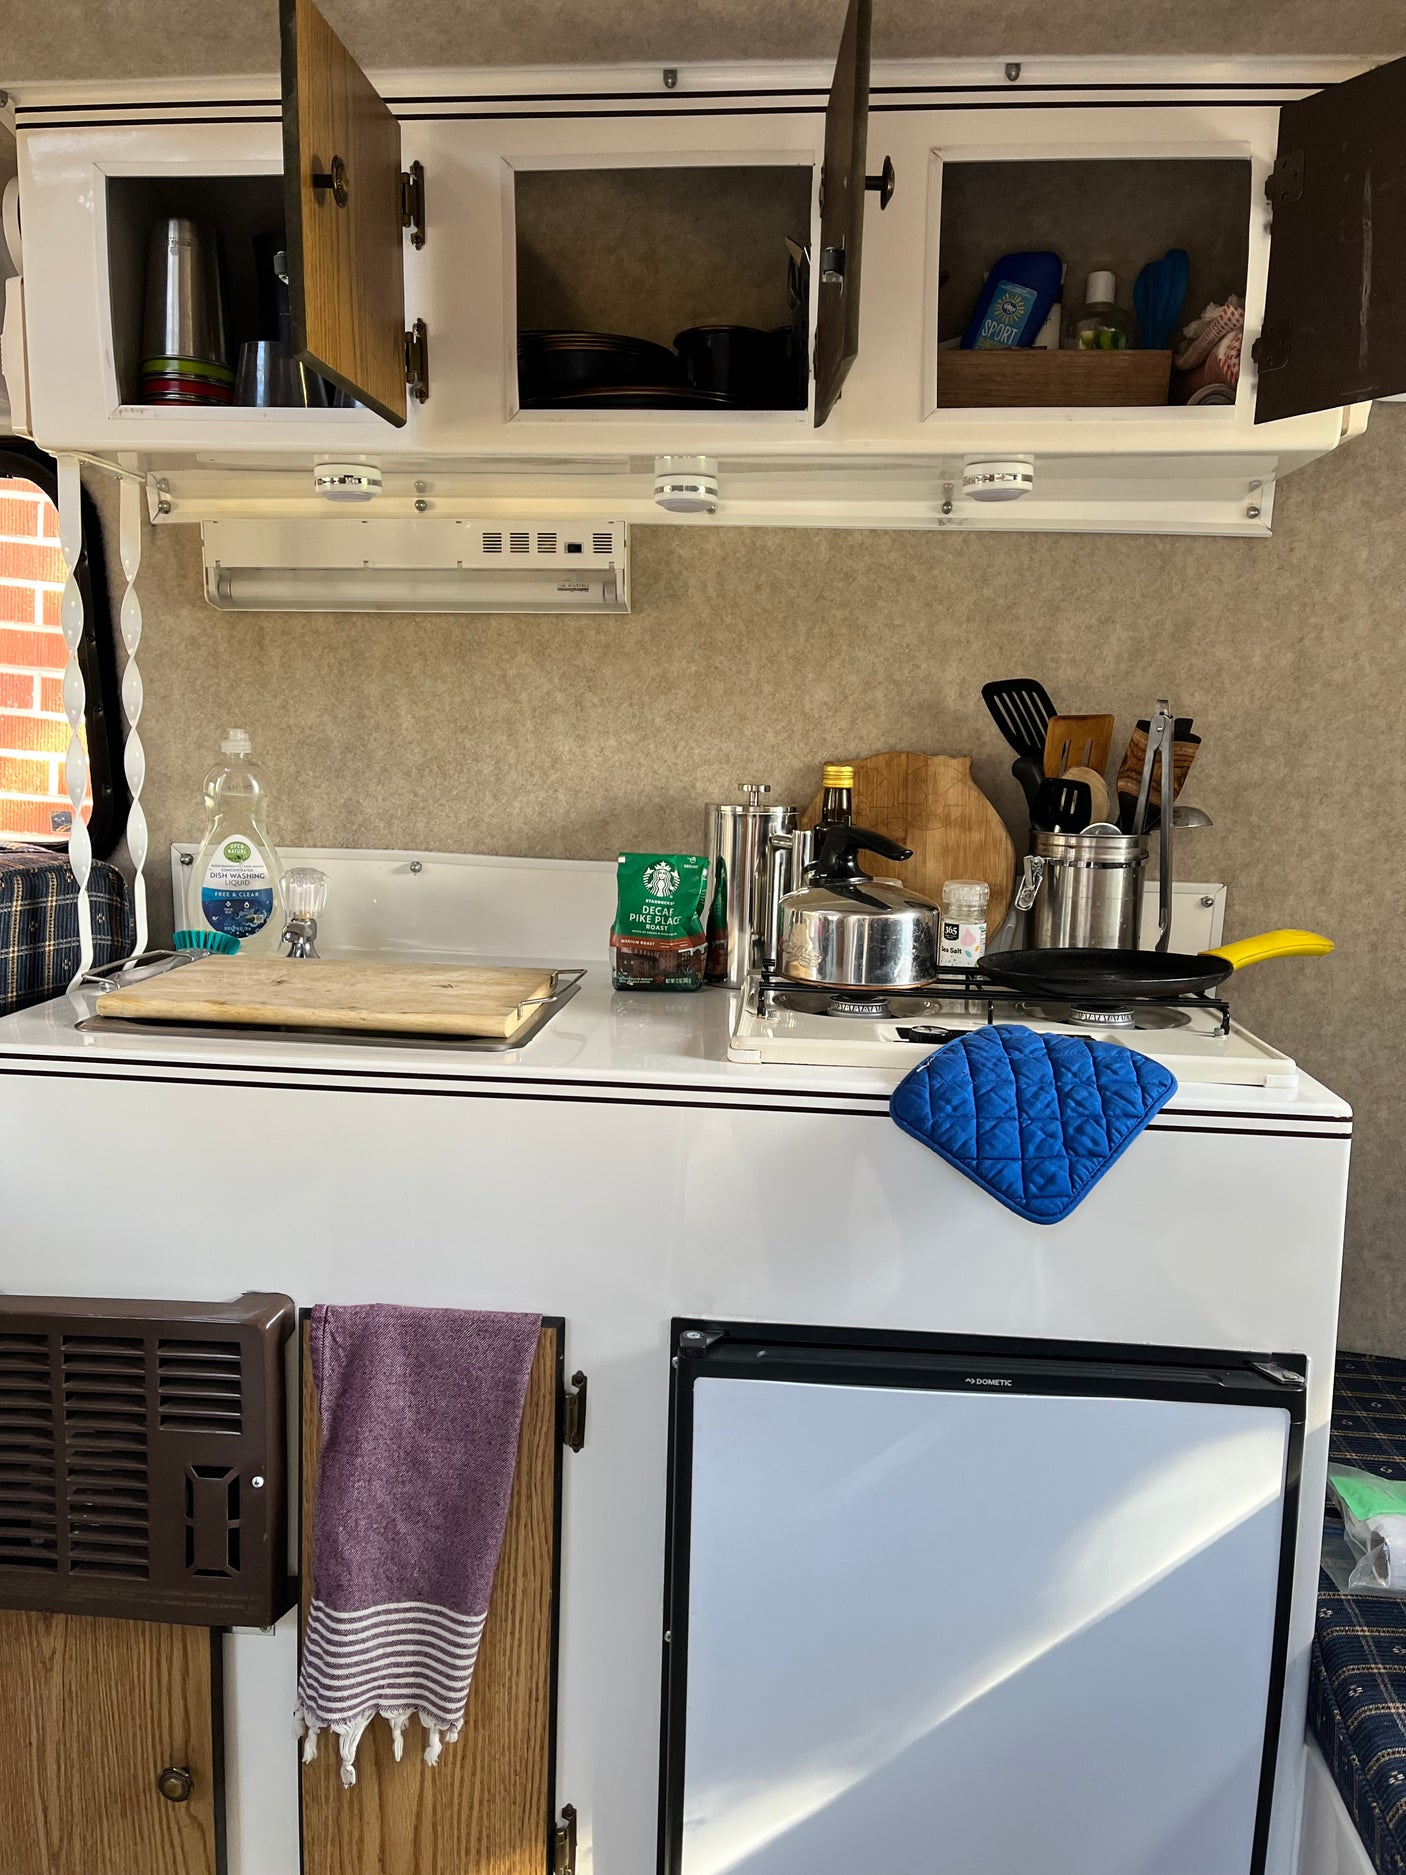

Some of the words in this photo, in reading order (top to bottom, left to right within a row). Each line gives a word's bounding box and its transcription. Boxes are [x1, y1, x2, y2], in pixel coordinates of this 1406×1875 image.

[981, 319, 1019, 345] SPORT
[642, 905, 674, 916] DECAF
[629, 913, 652, 923] PIKE
[945, 926, 957, 935] 365
[976, 1378, 1012, 1386] DOMETIC
